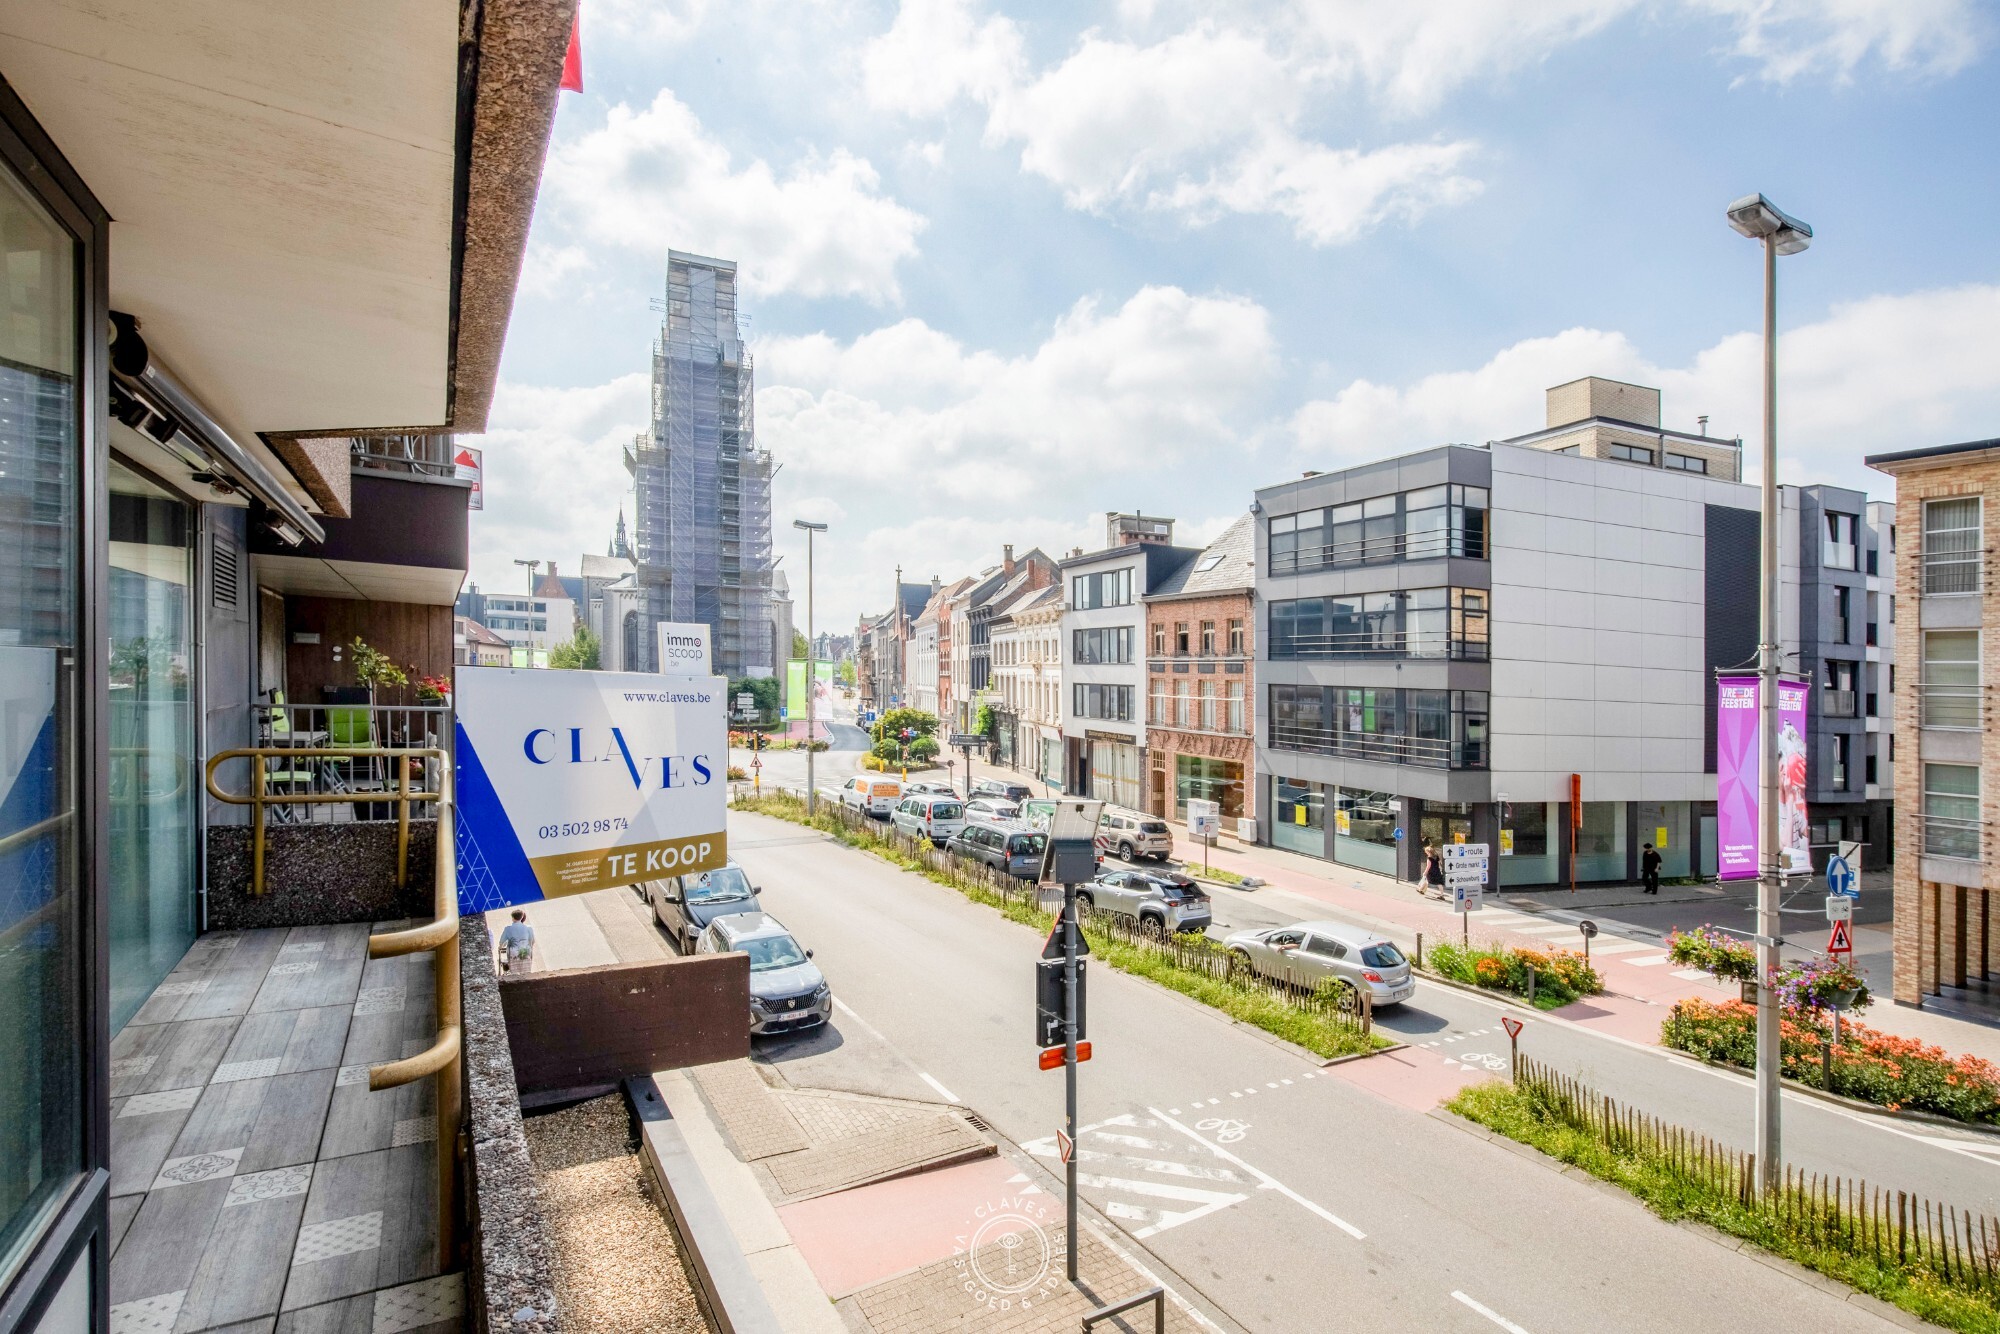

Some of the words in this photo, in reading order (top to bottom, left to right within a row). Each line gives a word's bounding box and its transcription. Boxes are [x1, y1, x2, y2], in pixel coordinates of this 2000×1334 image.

[667, 632, 701, 647] immo
[669, 648, 703, 661] scoop
[624, 692, 711, 703] www.claves.be
[1721, 698, 1754, 708] FEESTEN
[523, 727, 712, 791] CLAVES
[539, 825, 558, 839] 03
[562, 821, 590, 836] 502
[593, 819, 611, 832] 98
[613, 817, 629, 830] 74
[607, 853, 637, 878] TE
[646, 842, 711, 872] KOOP
